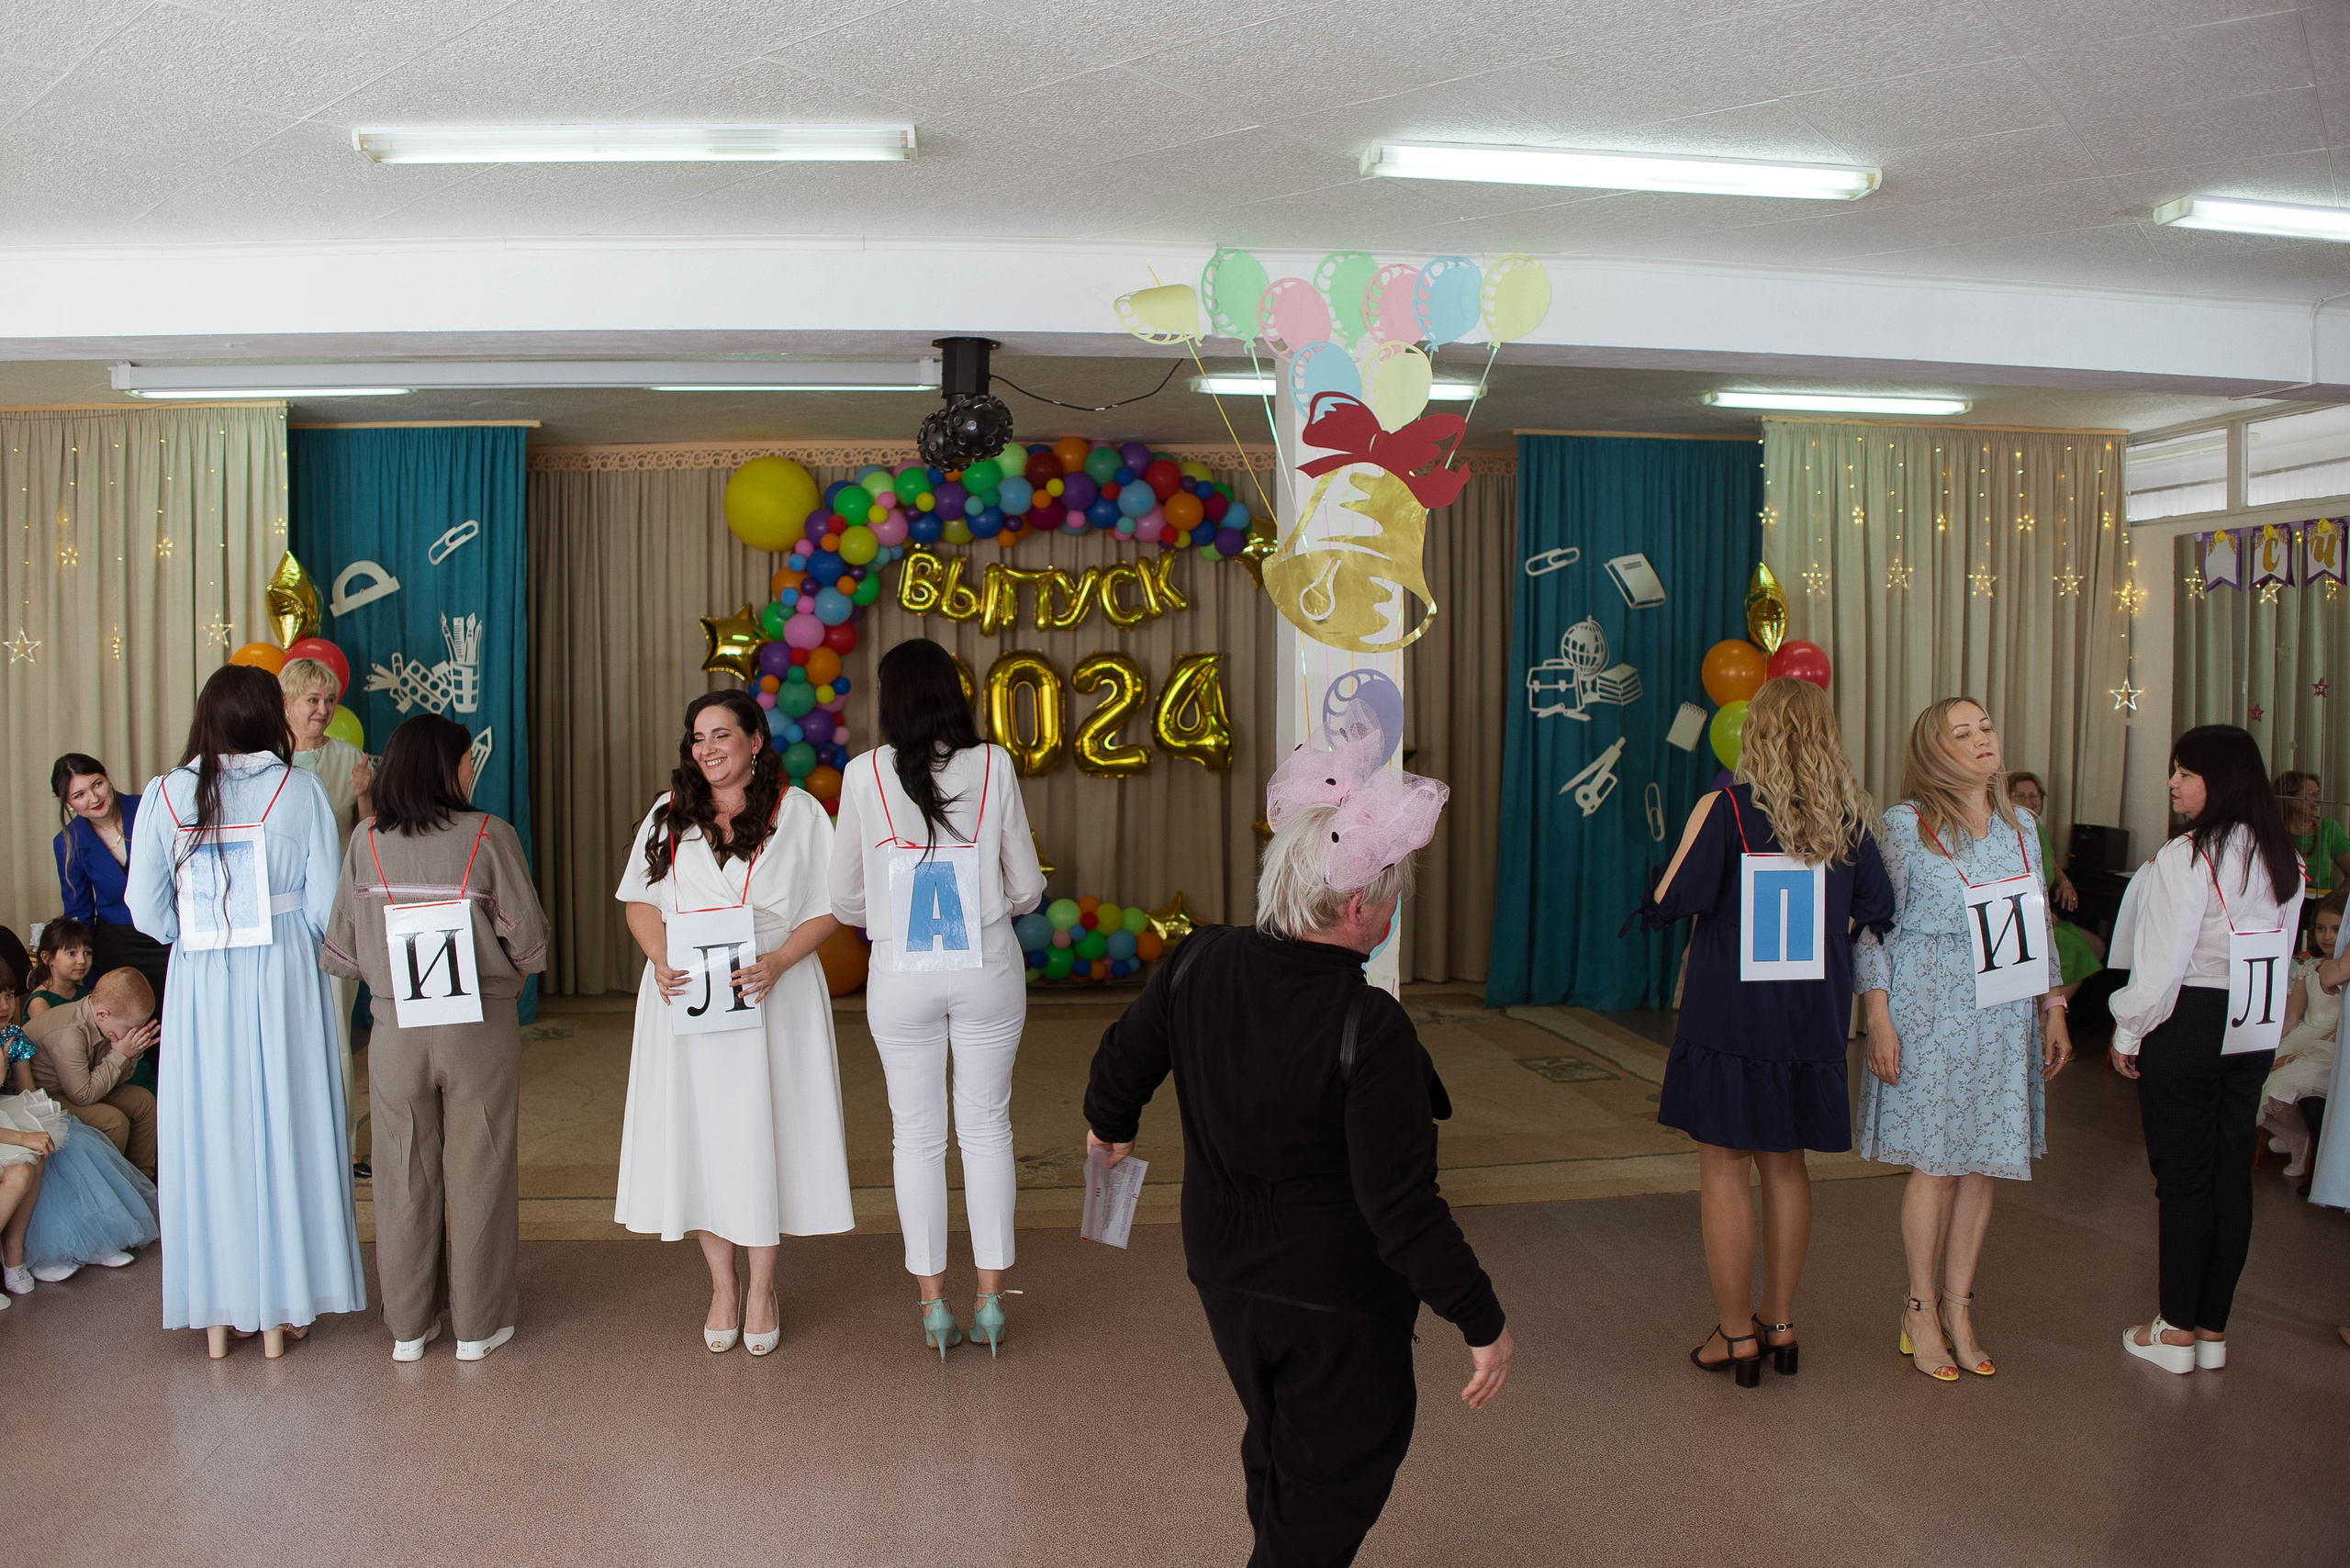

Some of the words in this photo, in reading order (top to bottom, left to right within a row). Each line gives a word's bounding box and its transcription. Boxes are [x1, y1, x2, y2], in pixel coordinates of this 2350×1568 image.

[898, 544, 1188, 636] ВЫПУСК
[951, 650, 1233, 778] 024
[906, 861, 969, 952] А
[1753, 870, 1814, 962] П
[1967, 891, 2037, 974] И
[396, 928, 472, 1001] И
[687, 941, 755, 1016] Л
[2232, 957, 2279, 1028] Л
